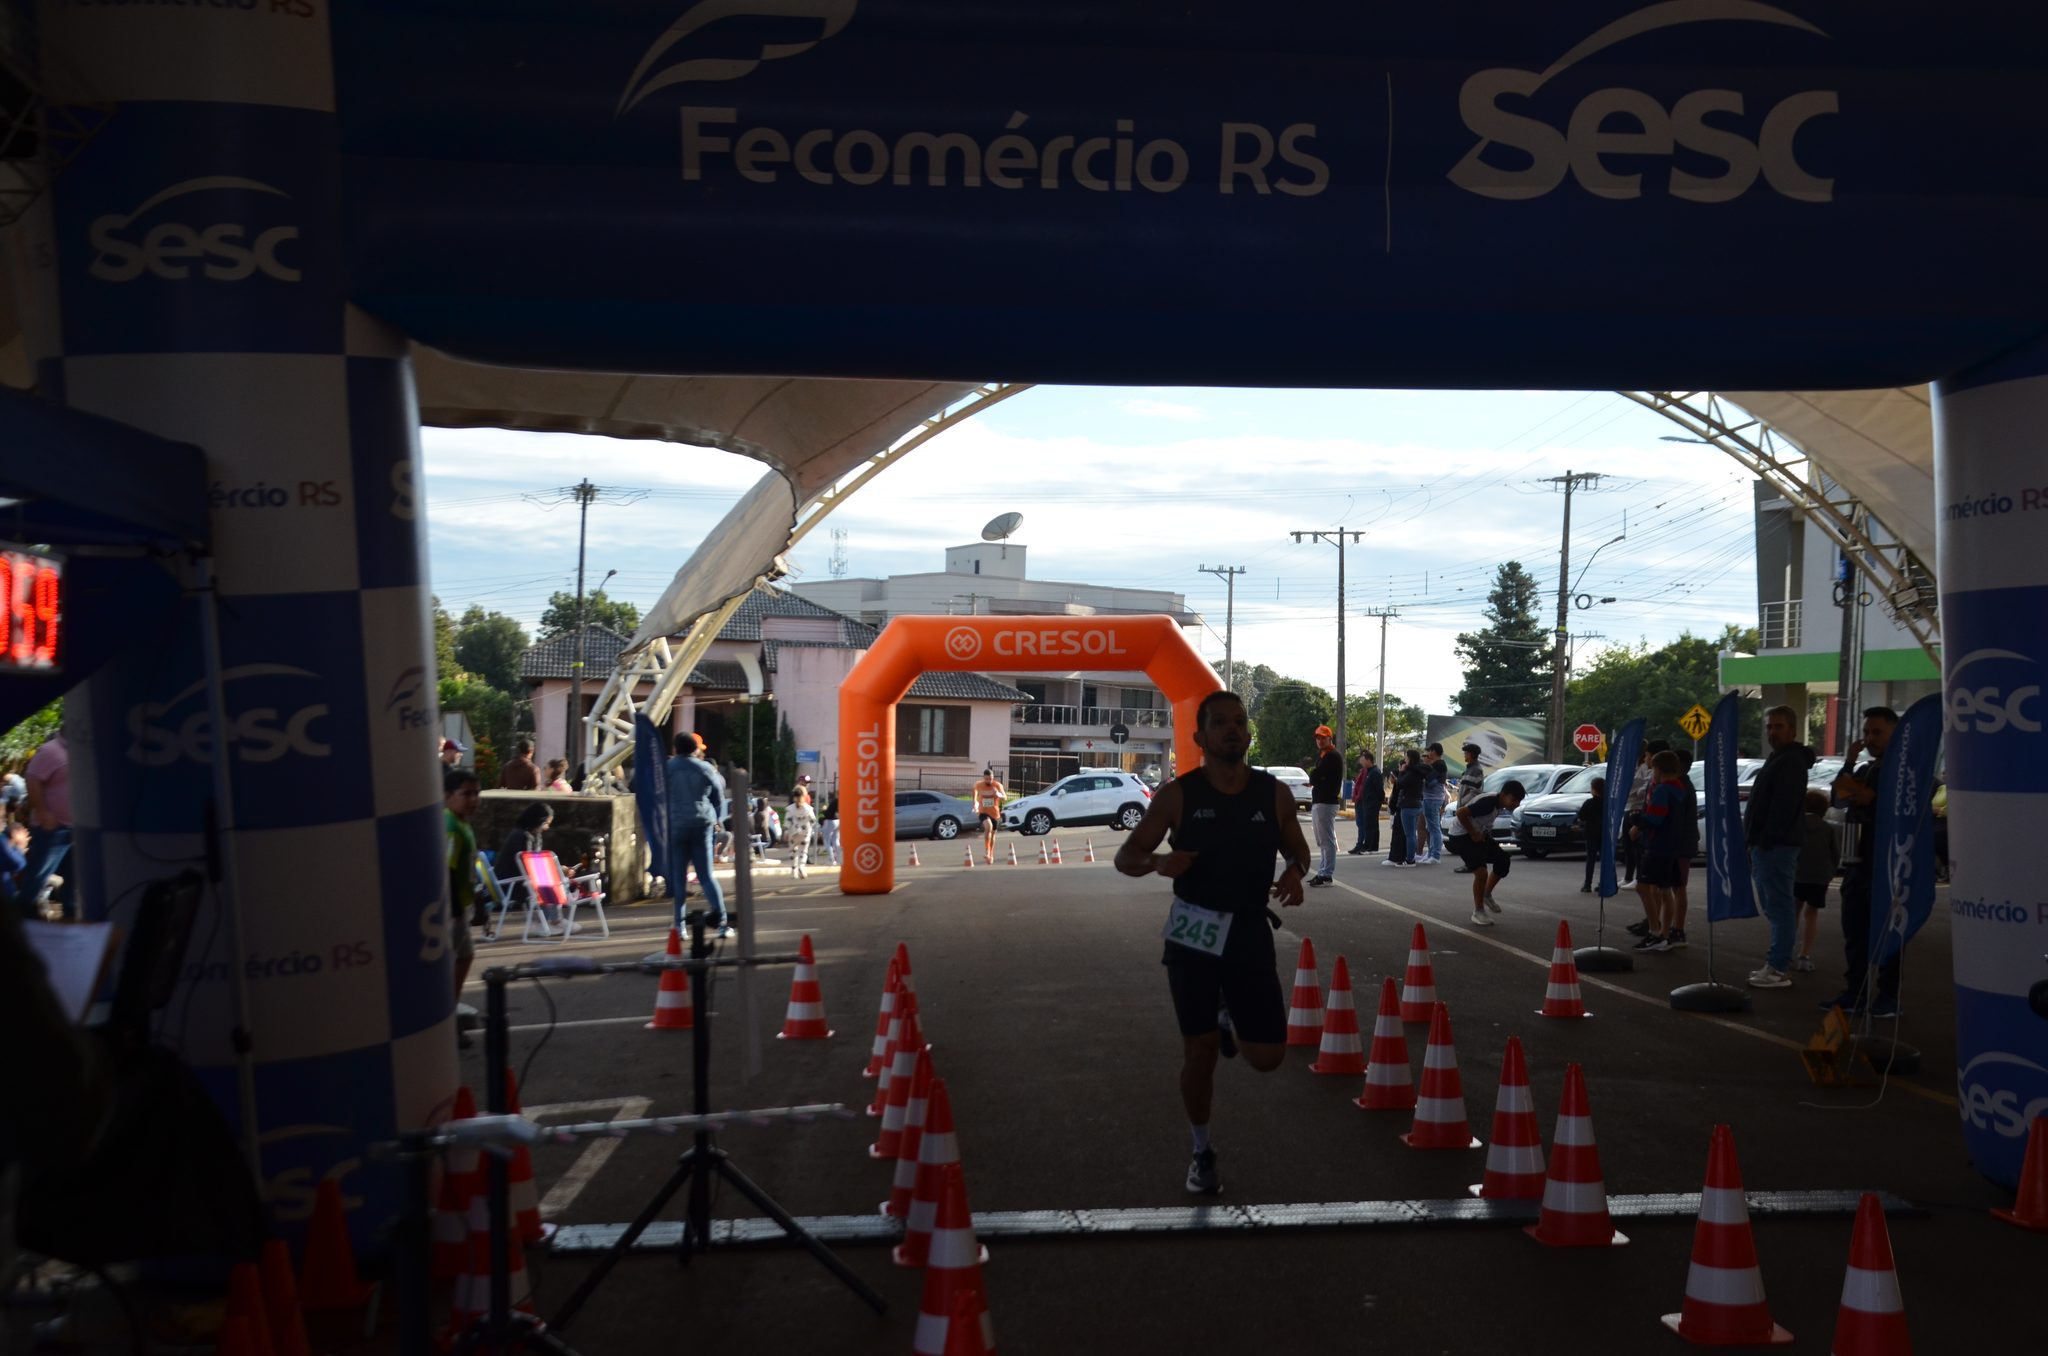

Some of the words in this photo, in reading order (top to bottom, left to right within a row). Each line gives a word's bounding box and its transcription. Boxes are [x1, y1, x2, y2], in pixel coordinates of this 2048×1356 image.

[680, 106, 1190, 193] Fecomércio
[1219, 122, 1331, 197] RS
[207, 481, 288, 508] ércio
[298, 481, 341, 506] RS
[993, 630, 1127, 656] CRESOL
[1575, 733, 1601, 743] PARE
[857, 722, 880, 834] CRESOL
[1171, 914, 1219, 948] 245
[332, 941, 373, 969] RS
